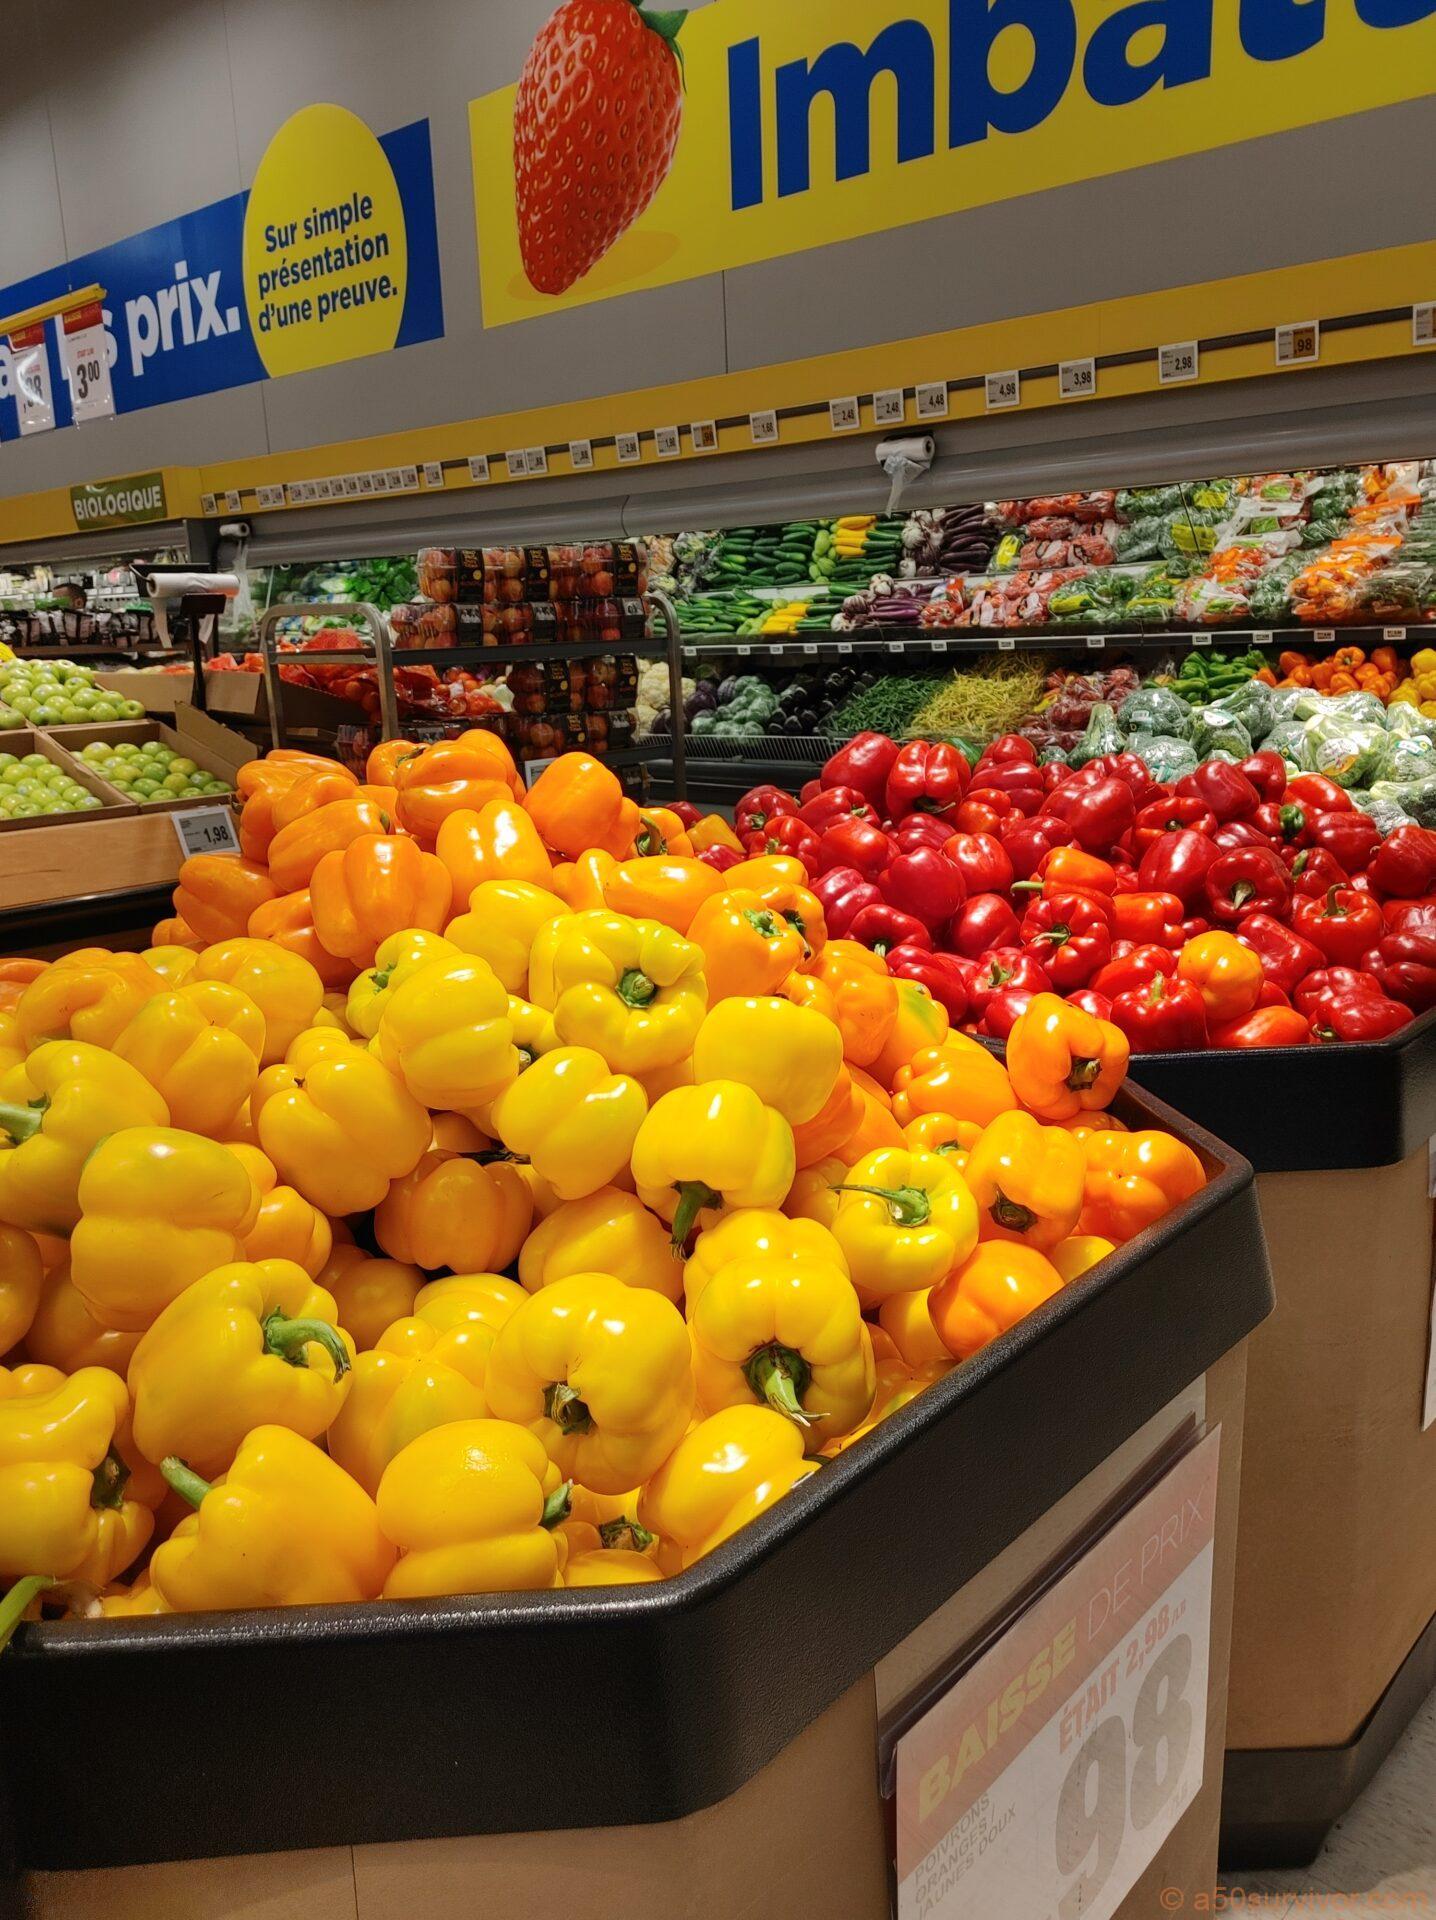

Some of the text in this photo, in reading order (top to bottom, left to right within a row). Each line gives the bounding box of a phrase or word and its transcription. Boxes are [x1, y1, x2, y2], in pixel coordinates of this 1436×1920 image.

[265, 192, 373, 252] Sur simple
[258, 233, 389, 299] présentation
[125, 260, 241, 377] prix.
[318, 275, 398, 322] preuve.
[999, 383, 1016, 397] 4,98
[1074, 371, 1092, 386] 3,98
[1175, 356, 1192, 371] 2,98
[74, 485, 162, 520] BIOLOGIQUE
[203, 825, 229, 844] 1,98
[919, 1485, 1206, 1824] BAISSE DE PRIX
[1060, 1658, 1120, 1755] ÉTAIT
[1125, 1602, 1170, 1680] 2,98
[915, 1793, 990, 1886] POIVRONS
[979, 1802, 1016, 1856] DOUX
[915, 1817, 987, 1904] ORANGES
